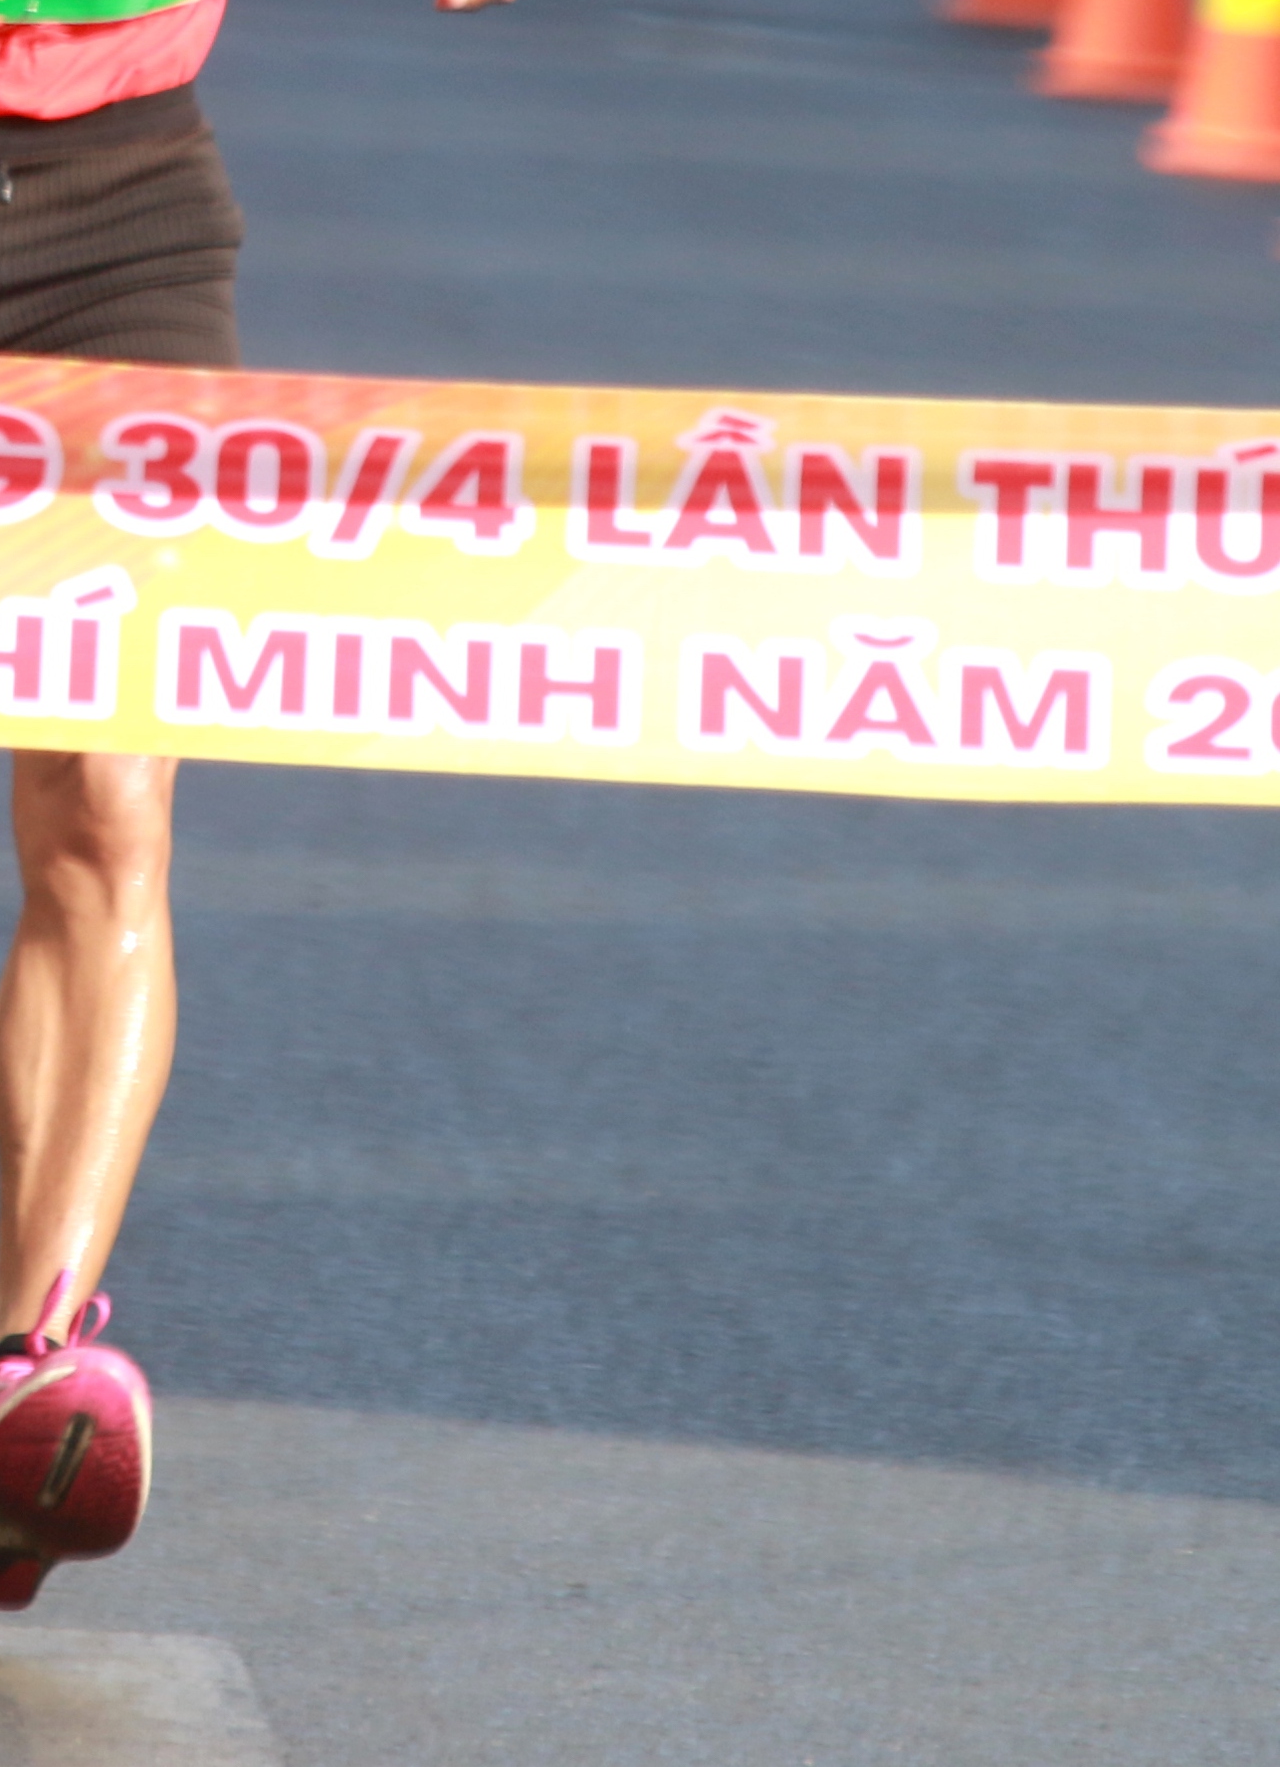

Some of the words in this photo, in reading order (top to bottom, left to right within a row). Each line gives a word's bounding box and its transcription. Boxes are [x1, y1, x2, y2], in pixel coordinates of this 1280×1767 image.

[110, 420, 516, 544] 30/4
[586, 414, 907, 560] LẦN
[176, 624, 622, 729] MINH
[699, 633, 1091, 755] NĂM
[1167, 674, 1280, 761] 2
